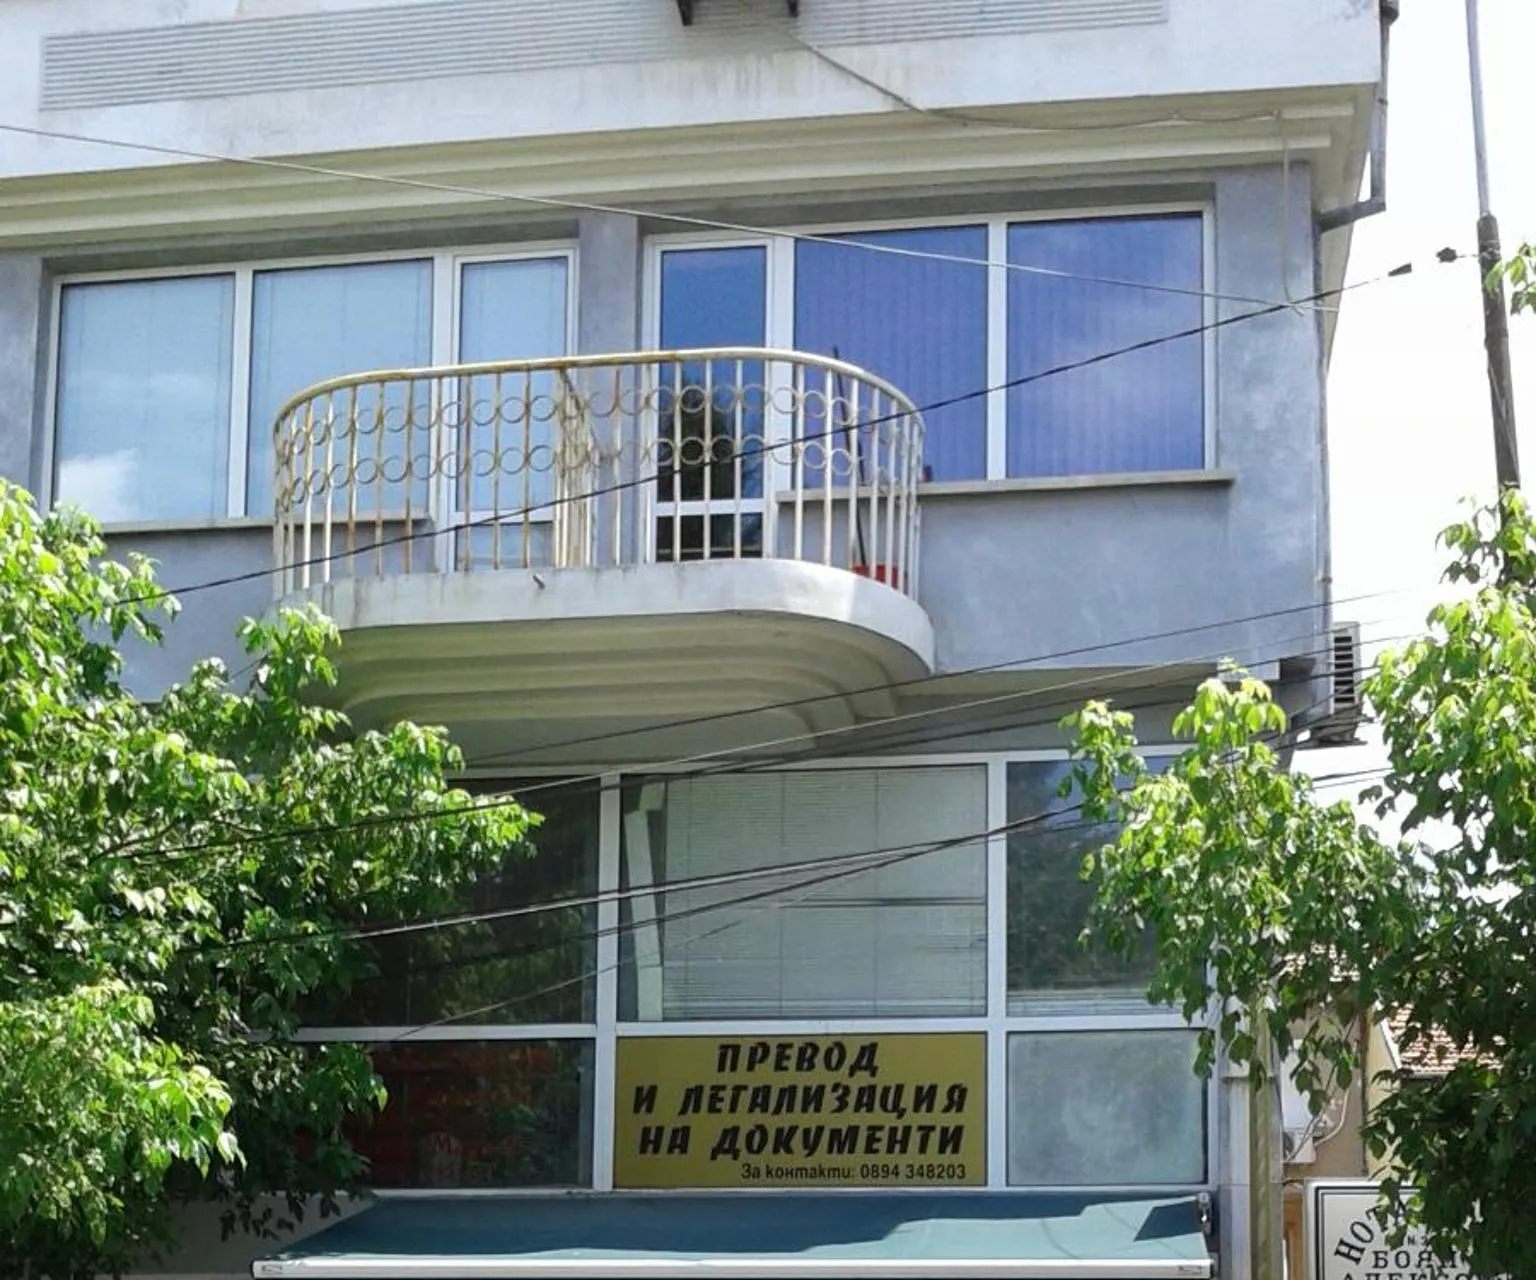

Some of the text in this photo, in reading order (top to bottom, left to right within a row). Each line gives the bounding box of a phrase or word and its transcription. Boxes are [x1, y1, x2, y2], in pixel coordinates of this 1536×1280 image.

[717, 1042, 879, 1077] ПРЕВОД
[633, 1082, 968, 1120] И ЛЕГАЛИЗАЦИЯ
[639, 1124, 965, 1160] НА ДОКУМЕНТИ
[741, 1164, 761, 1178] За
[860, 1164, 900, 1178] 0894
[905, 1164, 966, 1178] 348203
